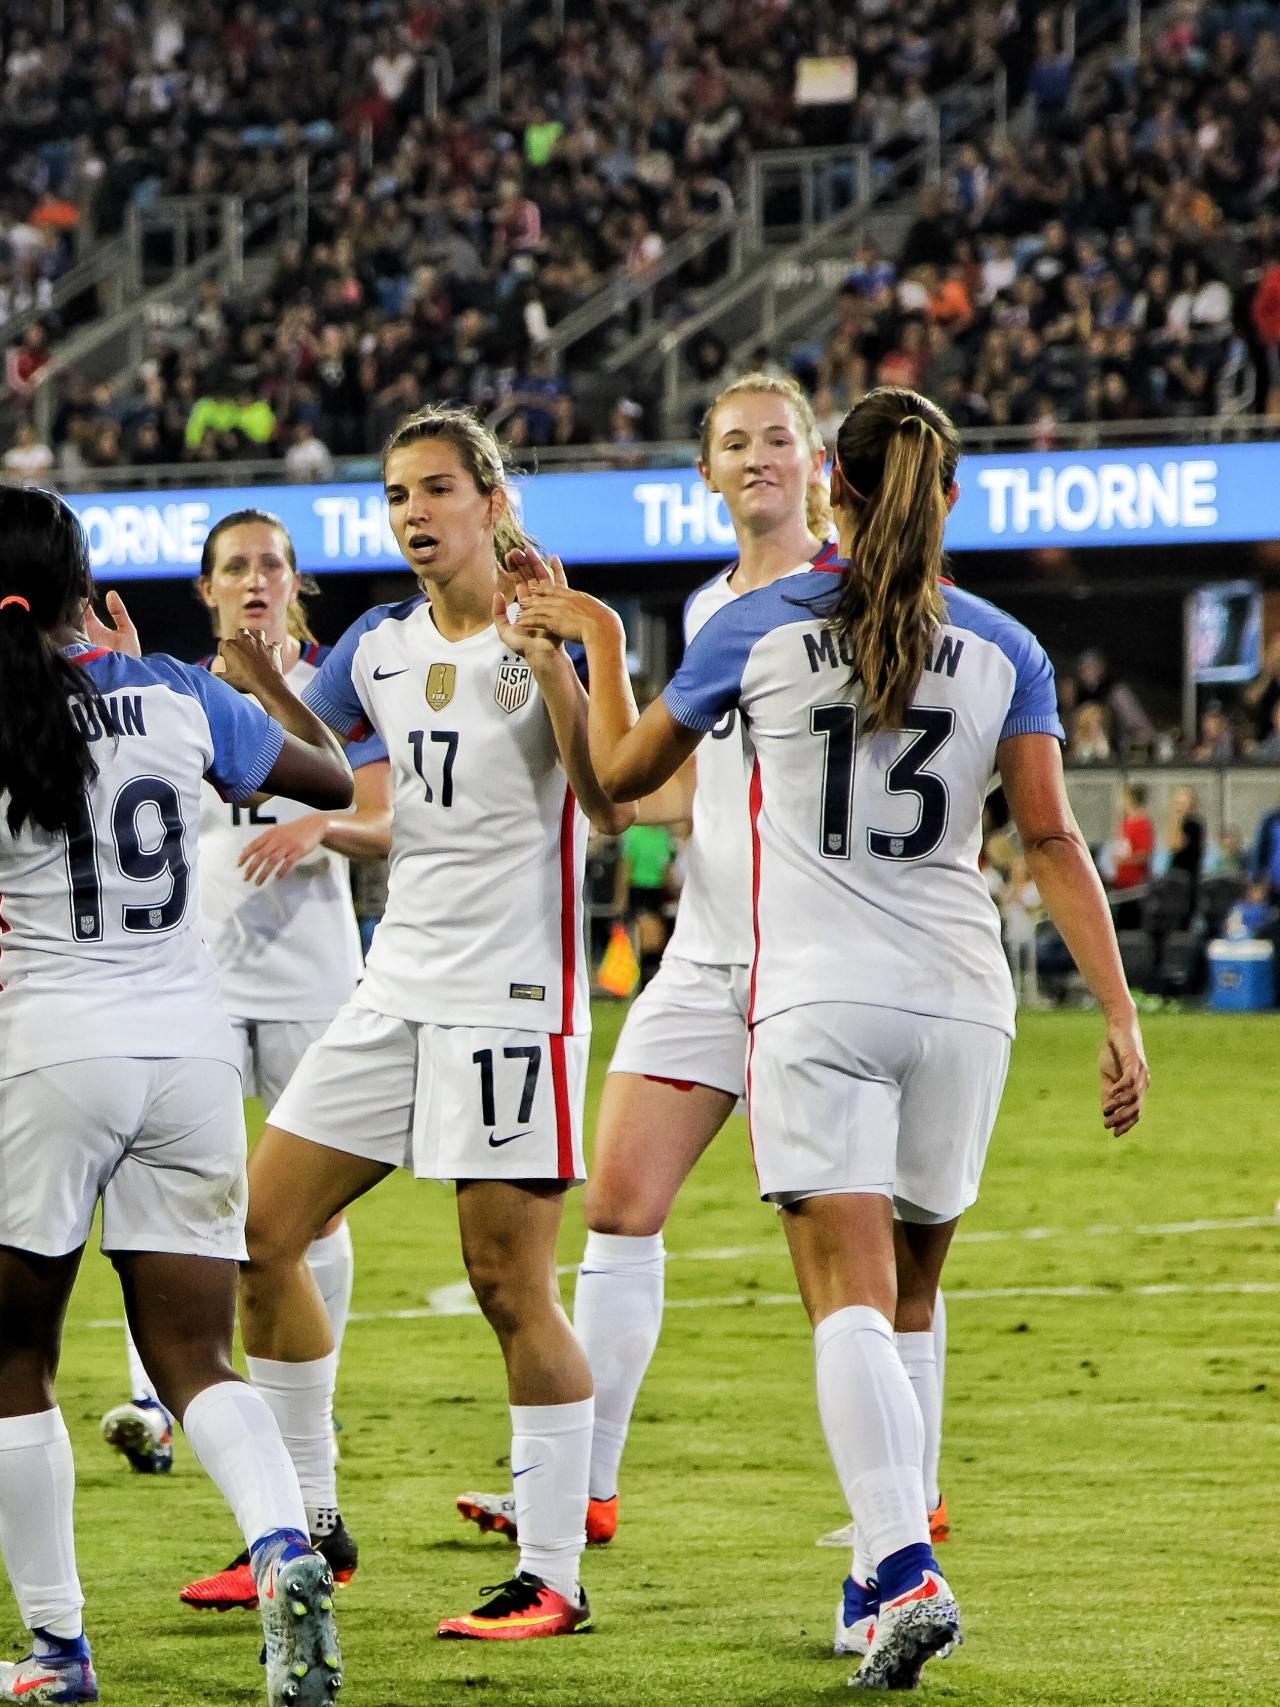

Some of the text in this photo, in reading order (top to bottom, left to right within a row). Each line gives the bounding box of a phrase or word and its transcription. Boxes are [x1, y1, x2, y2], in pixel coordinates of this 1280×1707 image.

[634, 482, 737, 546] THO
[978, 461, 1218, 533] THORNE
[80, 503, 210, 566] ORNE
[500, 667, 529, 685] USA
[70, 695, 147, 742] UNN
[408, 730, 459, 807] 17
[809, 702, 956, 862] 13
[63, 775, 190, 943] 19
[473, 1046, 542, 1126] 17
